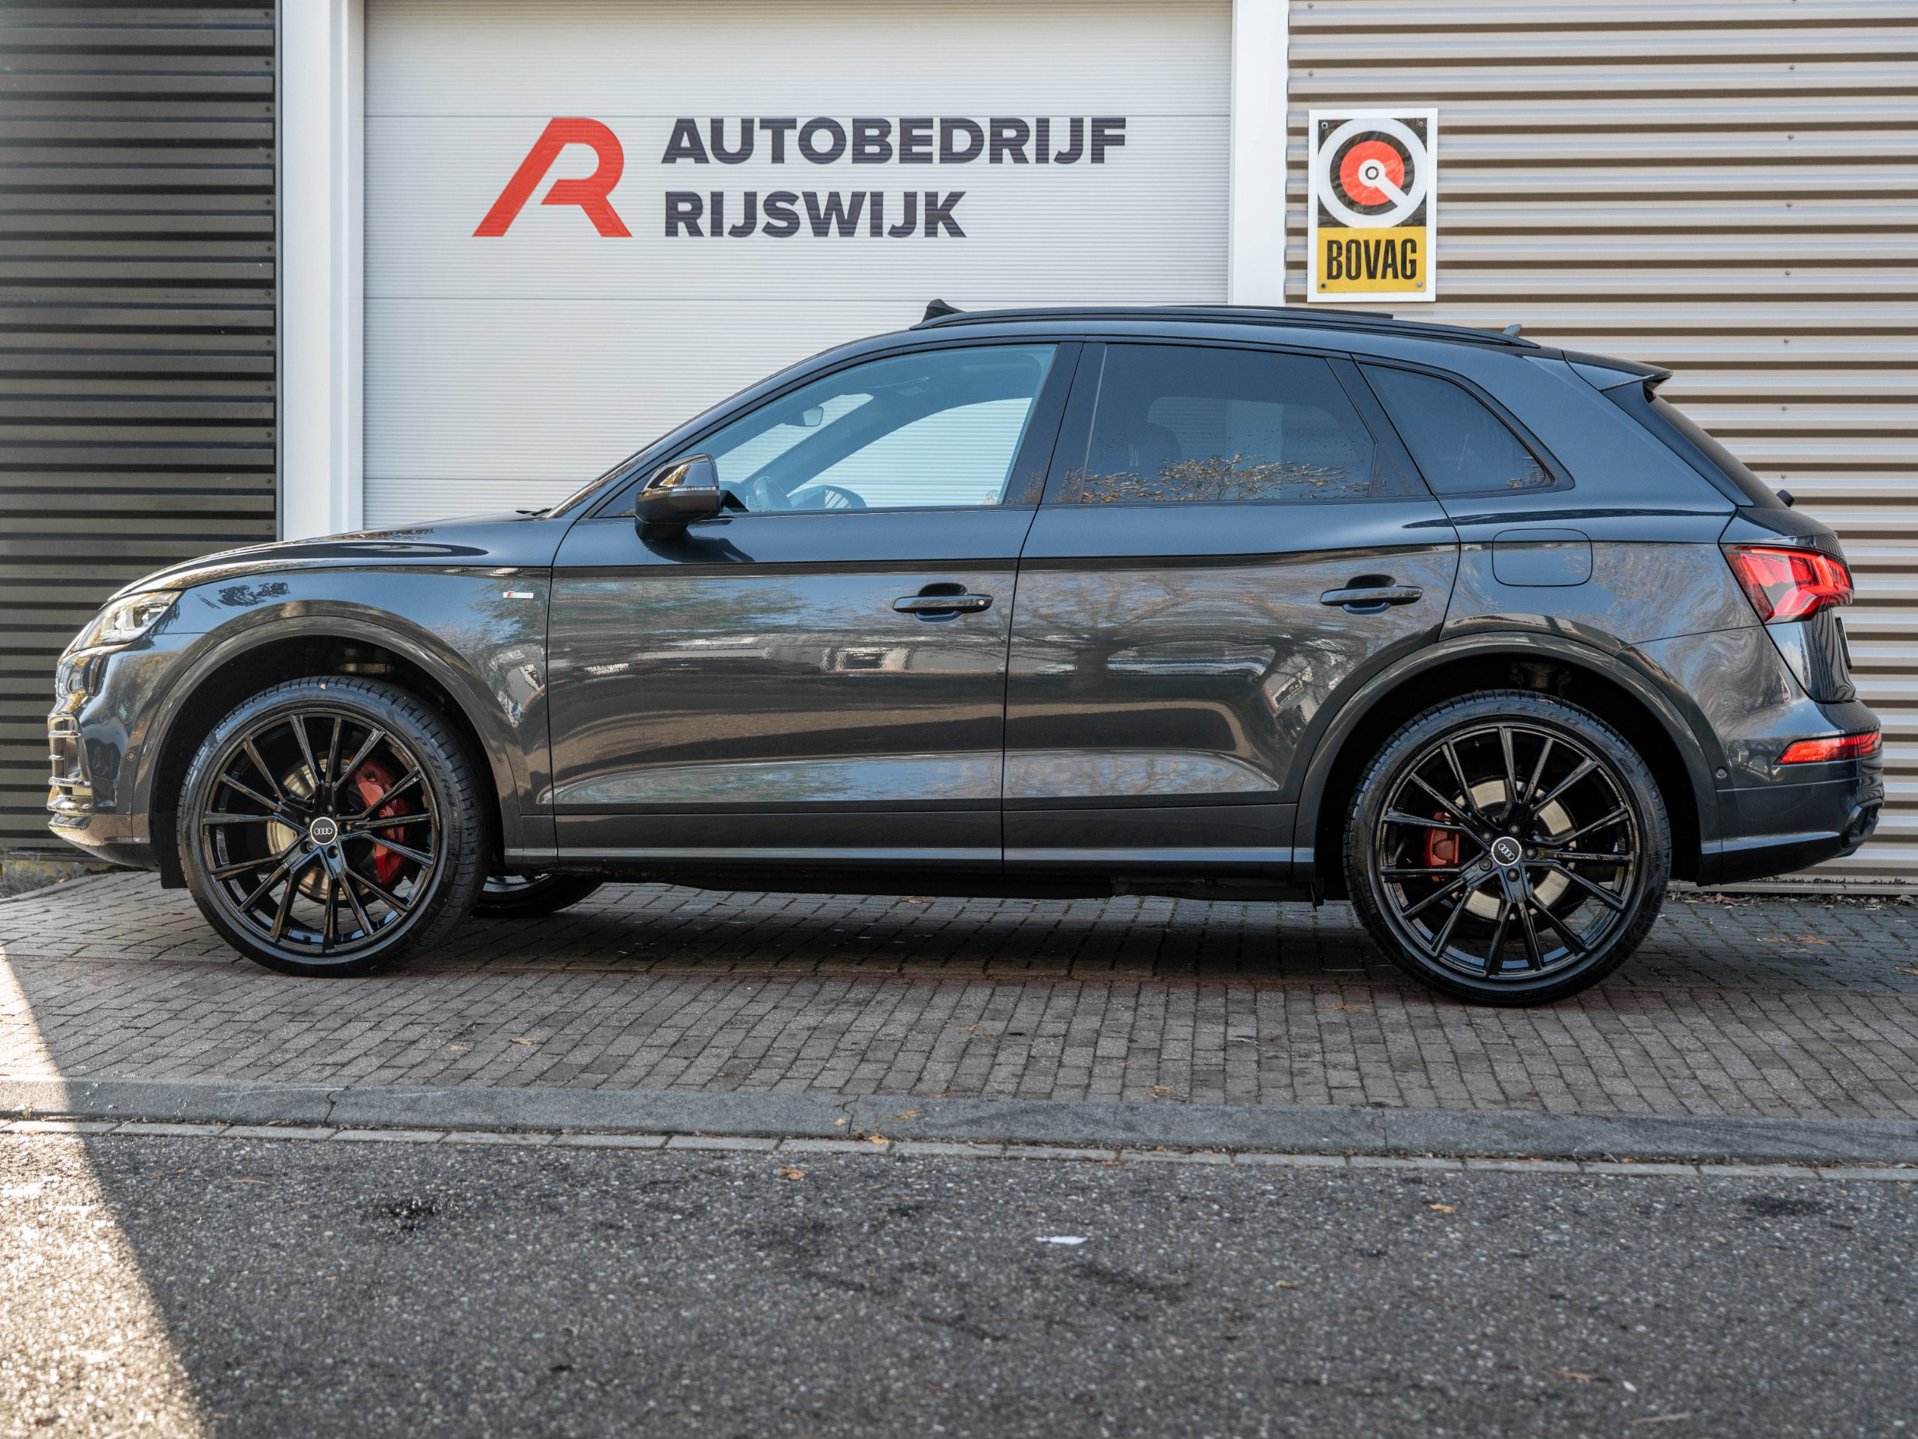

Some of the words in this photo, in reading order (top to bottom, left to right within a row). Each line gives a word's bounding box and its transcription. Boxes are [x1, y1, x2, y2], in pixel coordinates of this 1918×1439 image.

[661, 117, 1127, 165] AUTOBEDRIJF
[665, 190, 967, 238] RIJSWIJK
[1326, 238, 1417, 281] BOVAG
